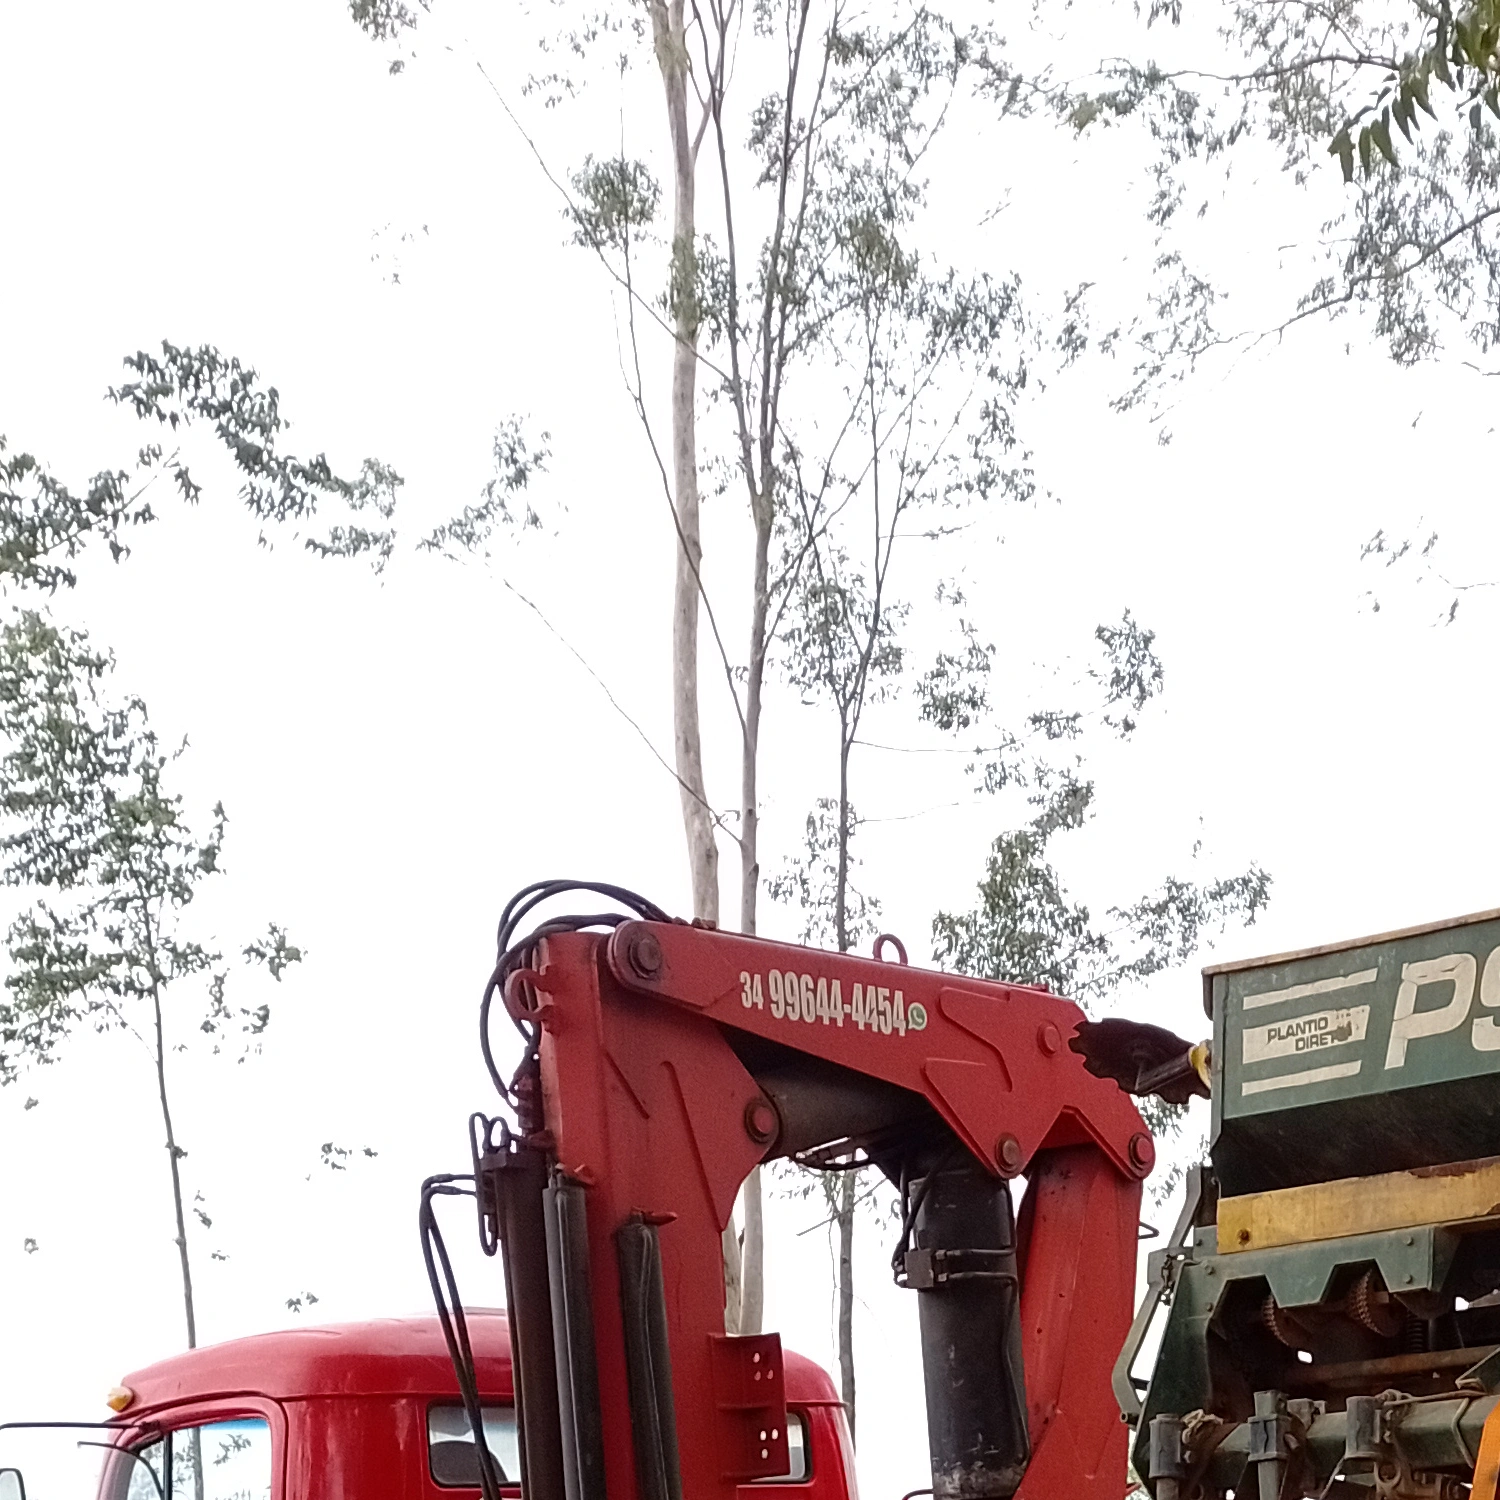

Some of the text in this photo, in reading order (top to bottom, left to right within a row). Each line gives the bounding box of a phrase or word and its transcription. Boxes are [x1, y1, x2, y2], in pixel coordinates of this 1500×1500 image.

[739, 968, 907, 1038] 34 99644-4454
[1266, 1016, 1329, 1045] PLANTIO
[1294, 1022, 1351, 1052] DIRET
